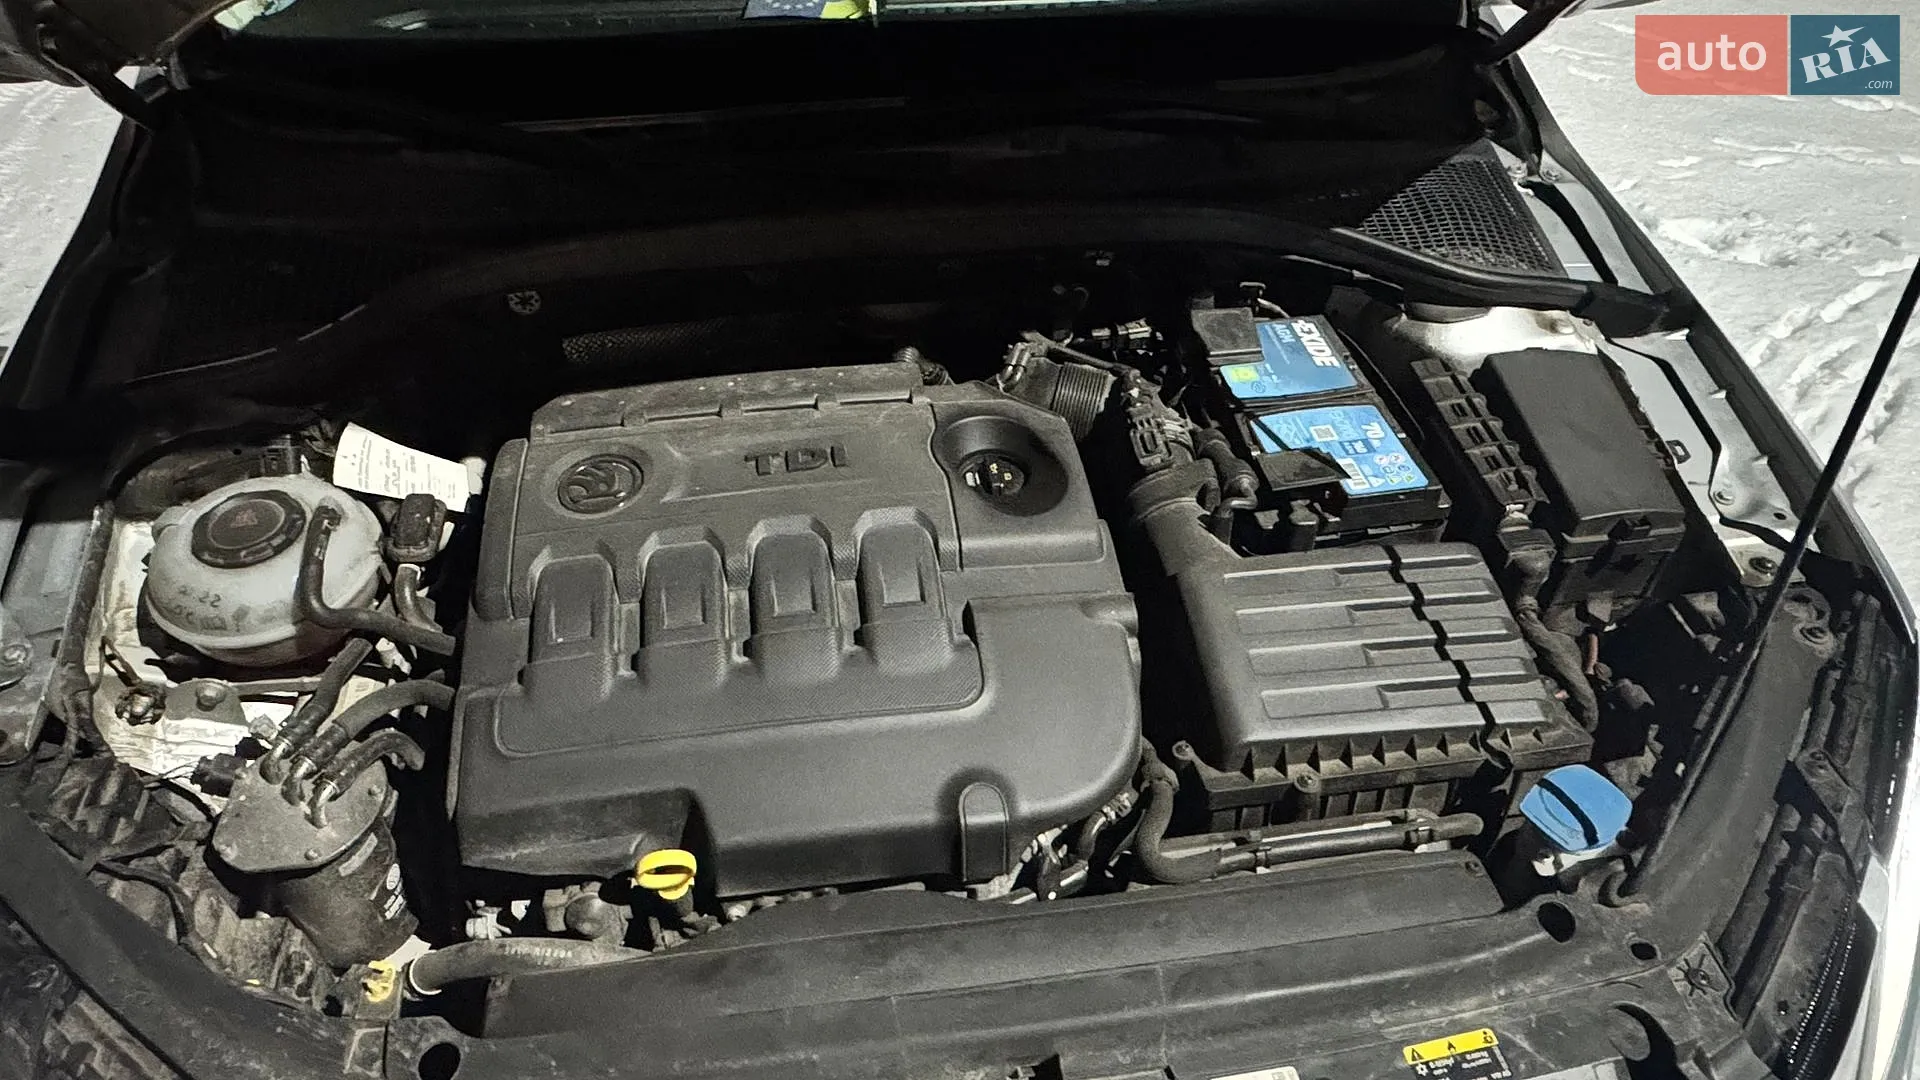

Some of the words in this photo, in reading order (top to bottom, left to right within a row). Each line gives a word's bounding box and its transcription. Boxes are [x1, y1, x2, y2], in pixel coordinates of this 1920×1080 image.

[1291, 320, 1341, 368] EXIDE
[1361, 421, 1385, 439] 70
[743, 441, 848, 476] TDI
